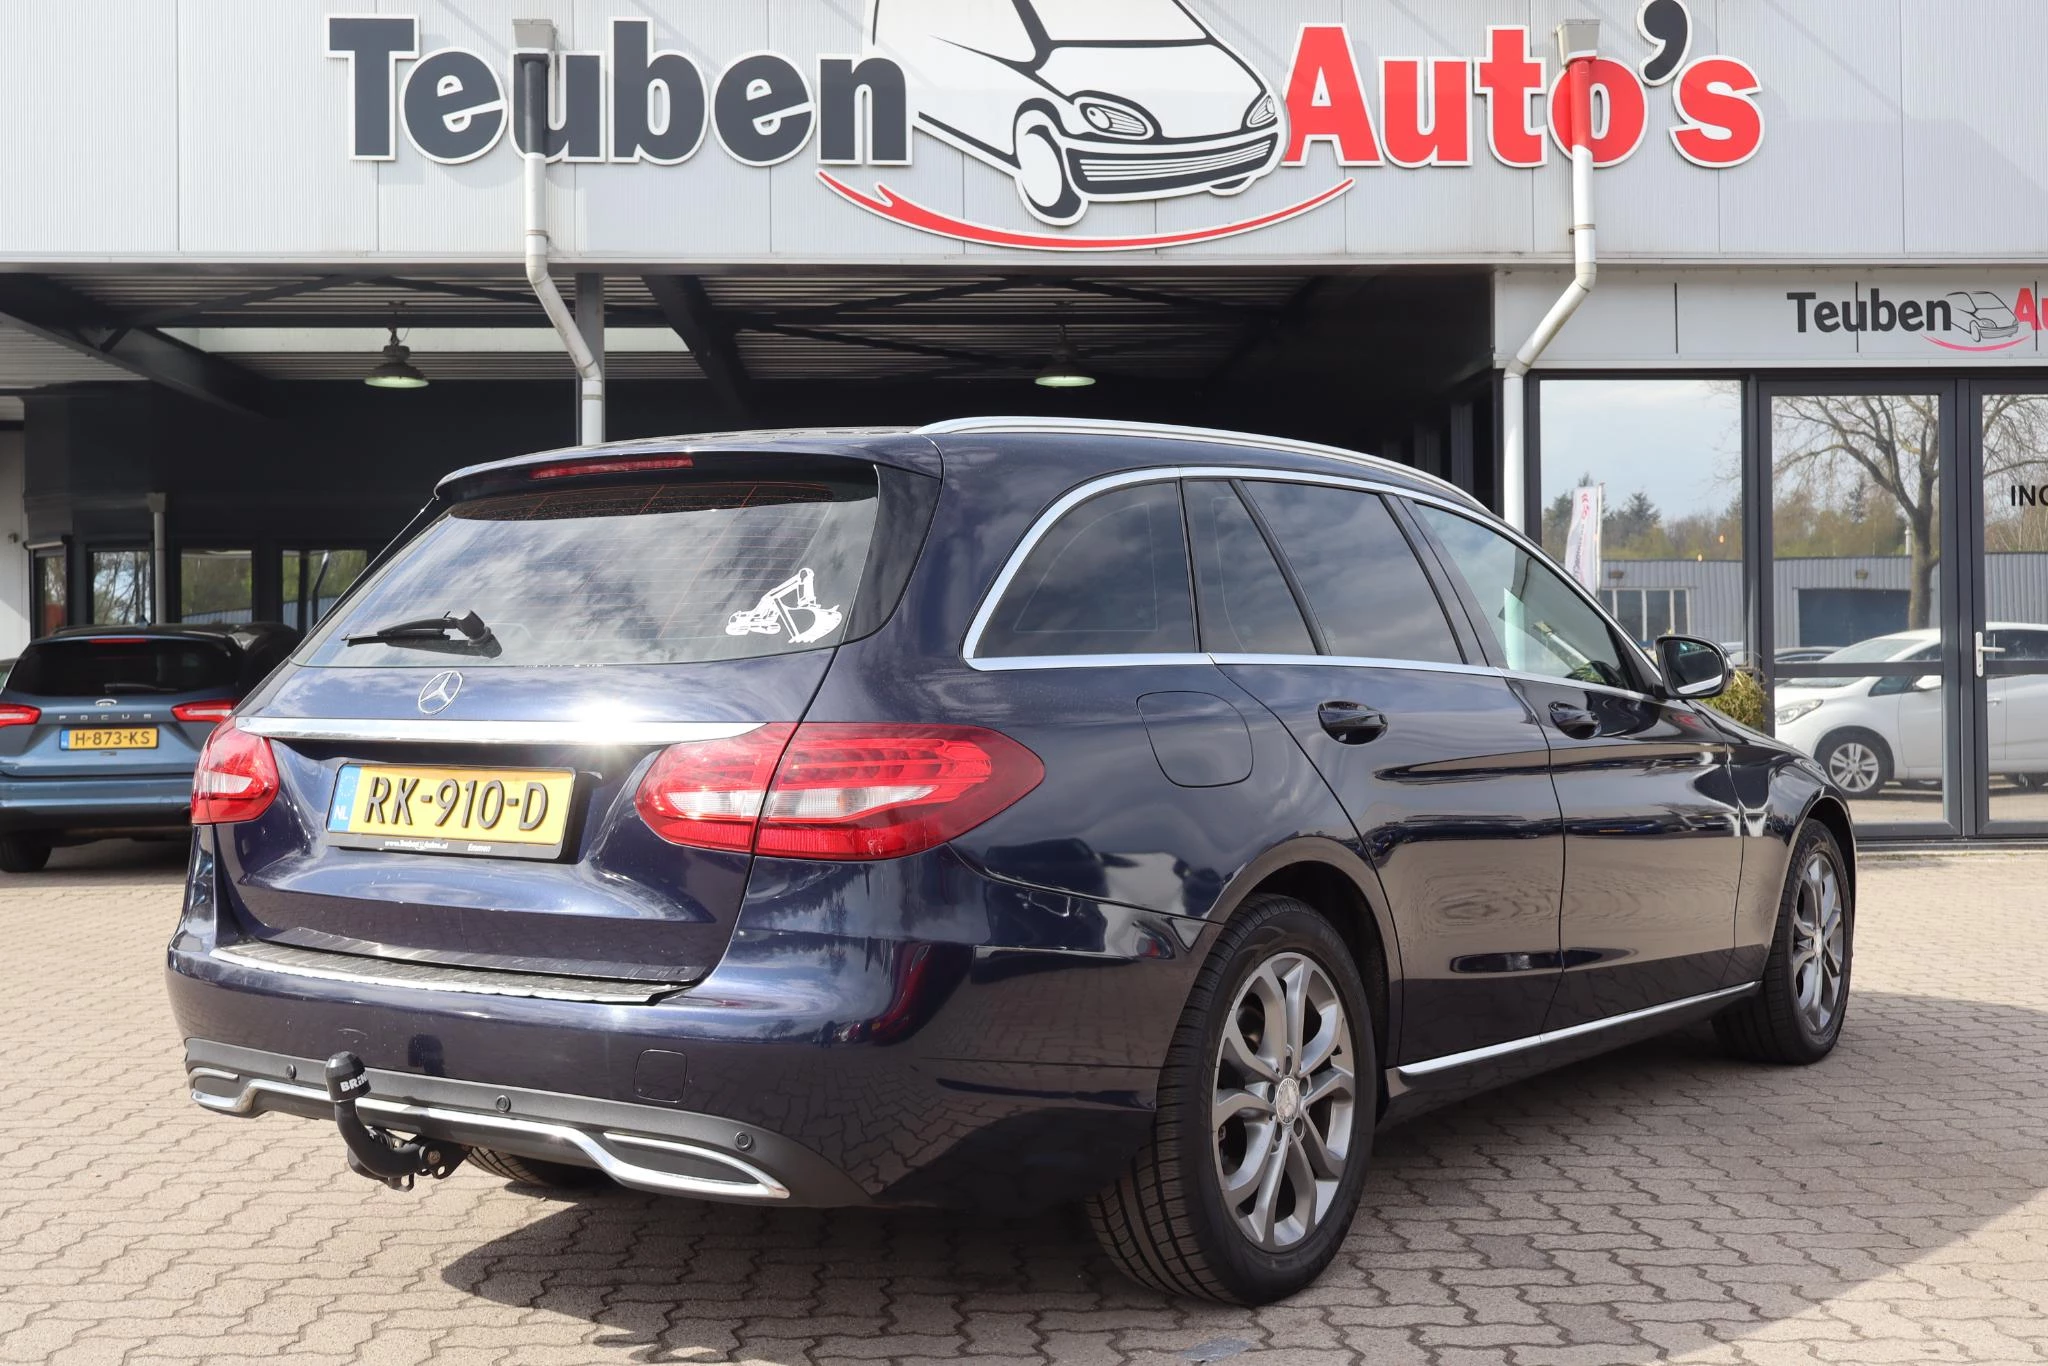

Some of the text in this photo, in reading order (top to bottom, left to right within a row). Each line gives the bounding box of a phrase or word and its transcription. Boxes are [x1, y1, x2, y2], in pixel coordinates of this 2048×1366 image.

[327, 0, 1764, 167] Teuben Auto's
[1787, 287, 1952, 333] Teuben
[75, 730, 151, 746] H-873-KS
[334, 776, 549, 831] NL RK-910-D
